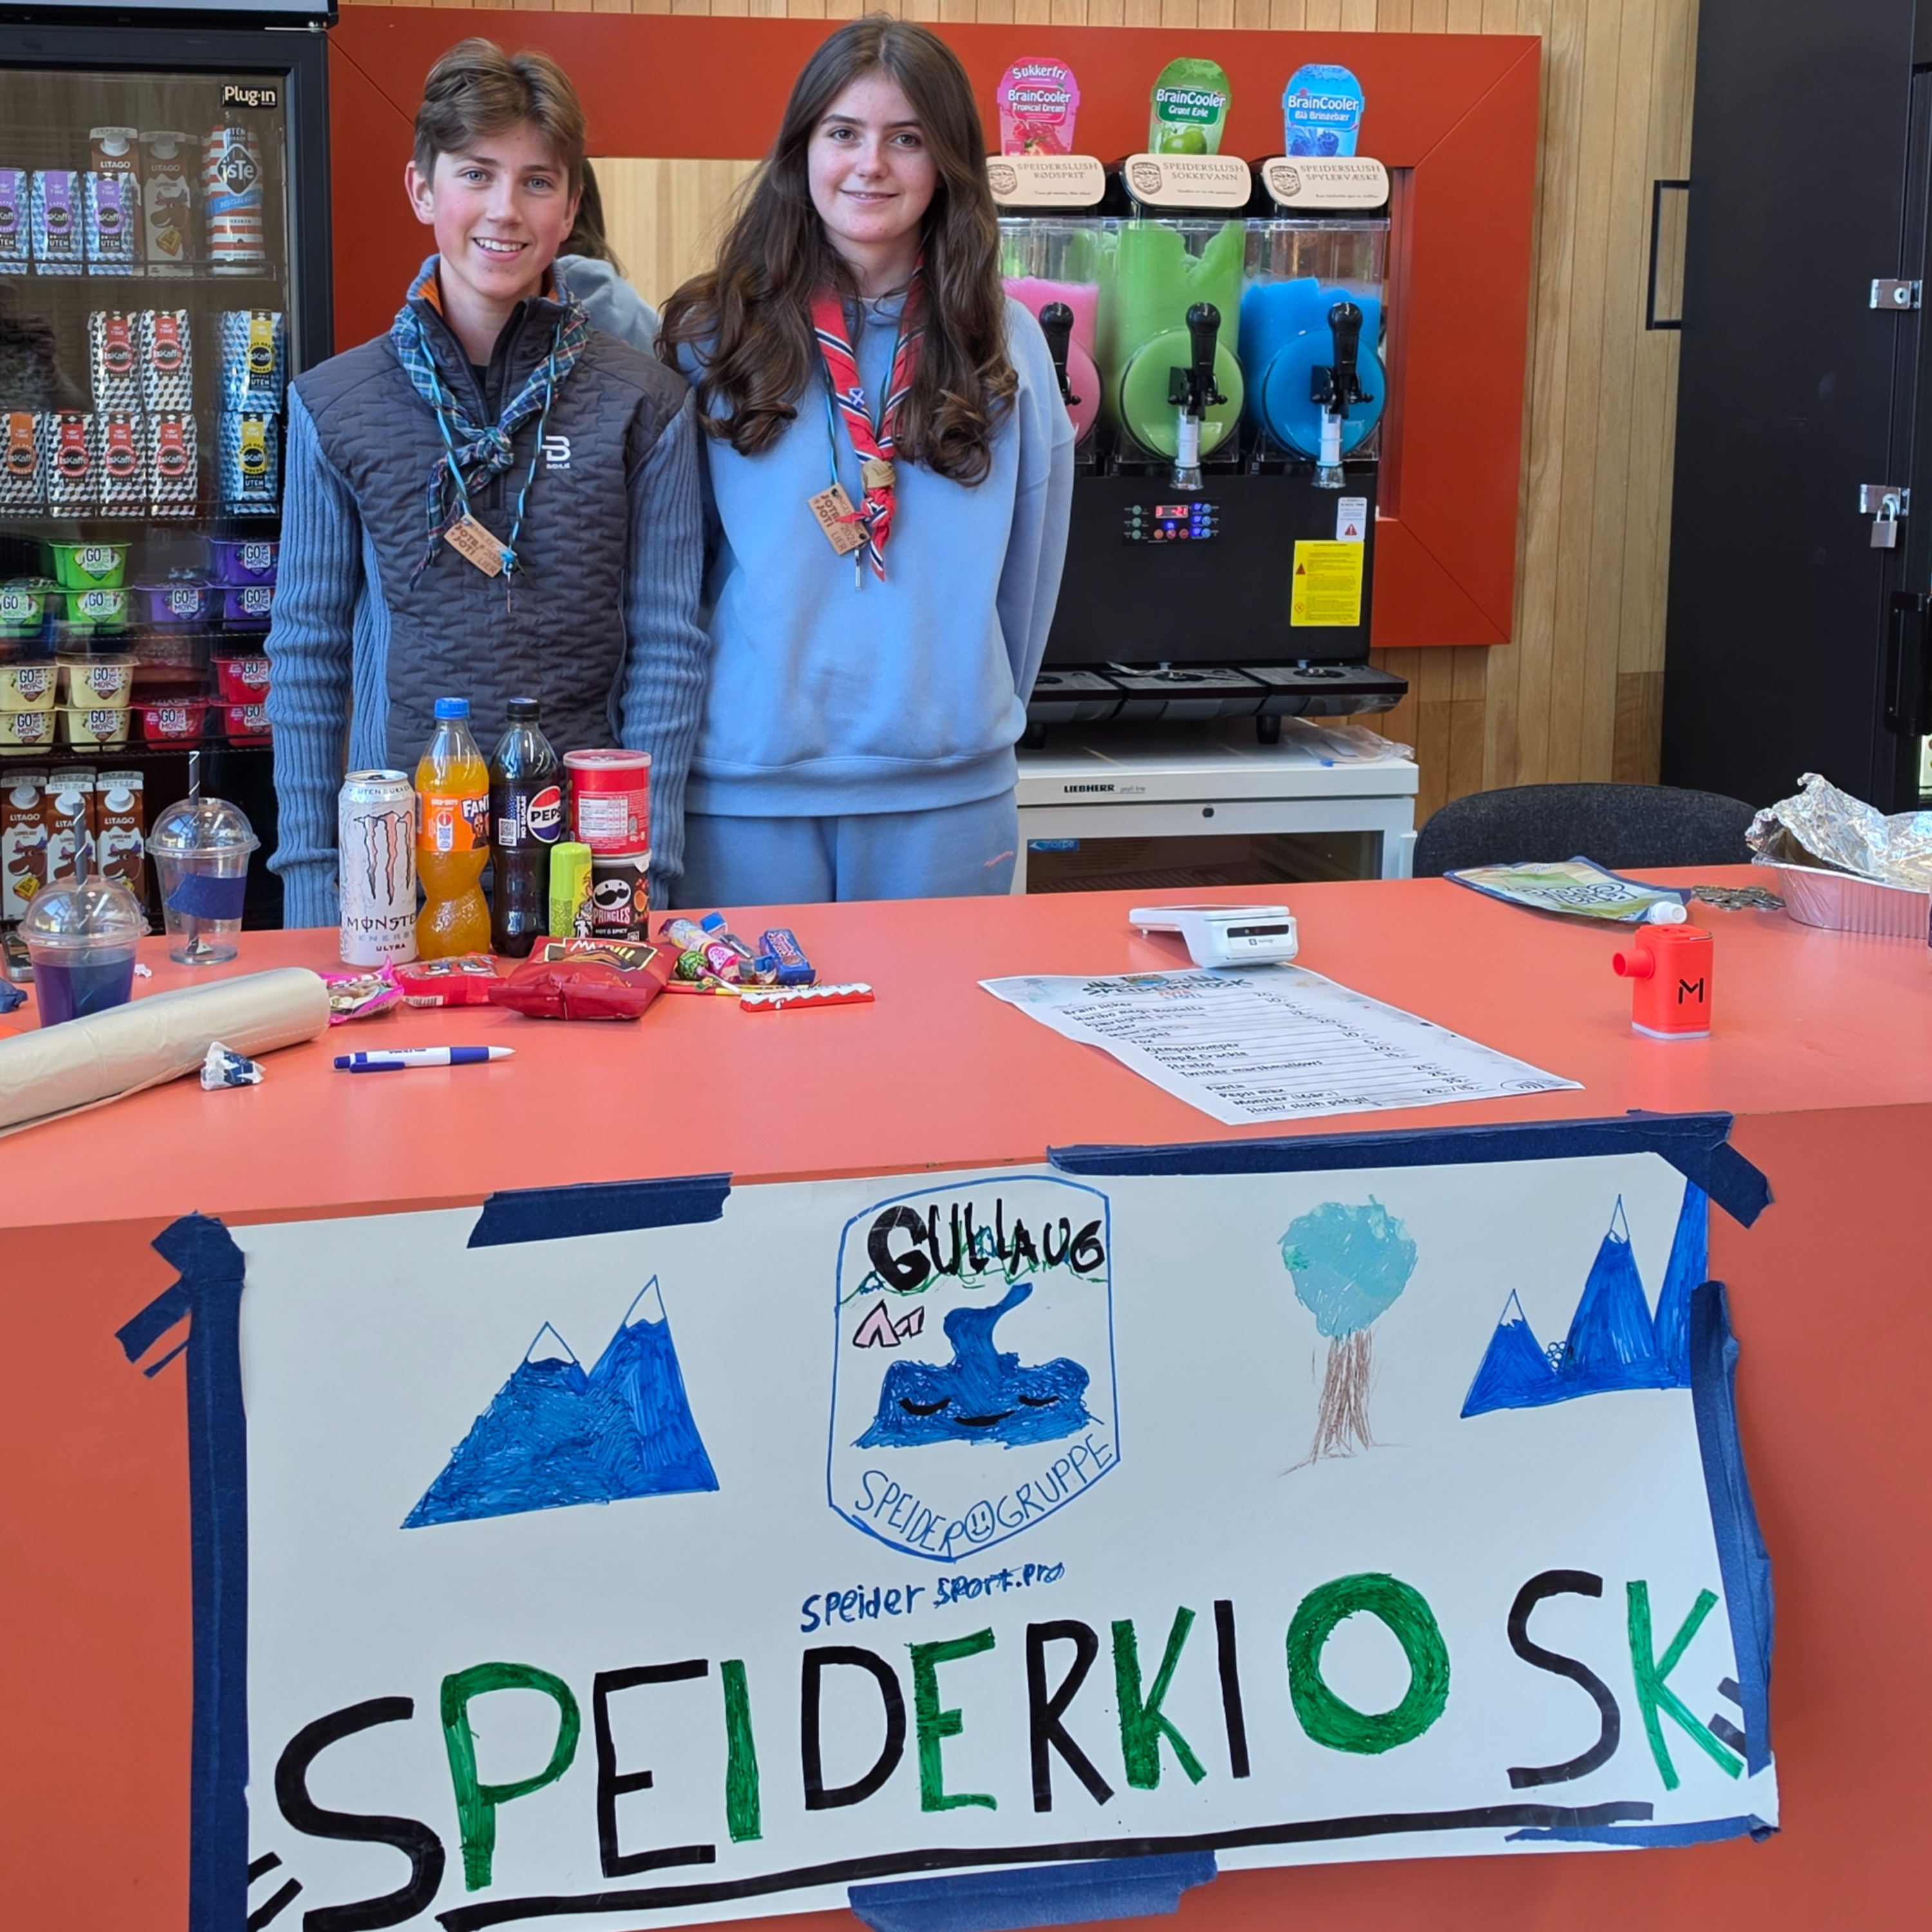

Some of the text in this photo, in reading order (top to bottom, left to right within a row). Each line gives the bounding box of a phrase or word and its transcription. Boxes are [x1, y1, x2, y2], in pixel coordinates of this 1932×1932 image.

[1012, 64, 1068, 80] Sukkerfri
[1008, 89, 1072, 103] BrainCooler
[1156, 88, 1226, 108] BrainCooler
[1288, 95, 1359, 111] BrainCooler
[1017, 162, 1098, 171] SPEIDERSLUSH
[1163, 162, 1244, 173] SPEIDERSLUSH
[1300, 164, 1381, 173] SPEIDERSLUSH
[1171, 171, 1238, 181] SOKKEVANN
[831, 531, 847, 552] LIER
[840, 524, 857, 546] 2026
[86, 548, 101, 562] GO
[246, 545, 261, 559] GO
[477, 557, 497, 574] LIER
[3, 595, 18, 609] GO
[88, 592, 104, 606] GO
[175, 590, 189, 604] GO
[246, 589, 261, 603] GO
[93, 667, 109, 681] GO
[243, 661, 258, 674] GO
[19, 668, 35, 683] GO
[91, 710, 106, 723] GO
[161, 709, 176, 723] GO
[245, 705, 260, 717] GO
[17, 714, 32, 727] GO
[1064, 784, 1115, 793] LIEBHERR
[530, 805, 562, 822] PEPS
[55, 820, 77, 828] LITA
[521, 826, 527, 839] NO
[592, 905, 631, 925] PRINGLES
[347, 913, 416, 934] MONSTE
[376, 943, 406, 952] ULTRA
[1678, 977, 1705, 1005] M
[1166, 1061, 1215, 1070] Stratos
[1179, 1068, 1231, 1078] Twister
[1231, 1059, 1323, 1074] marshmallows
[1232, 1096, 1289, 1106] Monster
[1289, 1100, 1328, 1110] slush
[867, 1198, 1106, 1293] GULLAUG
